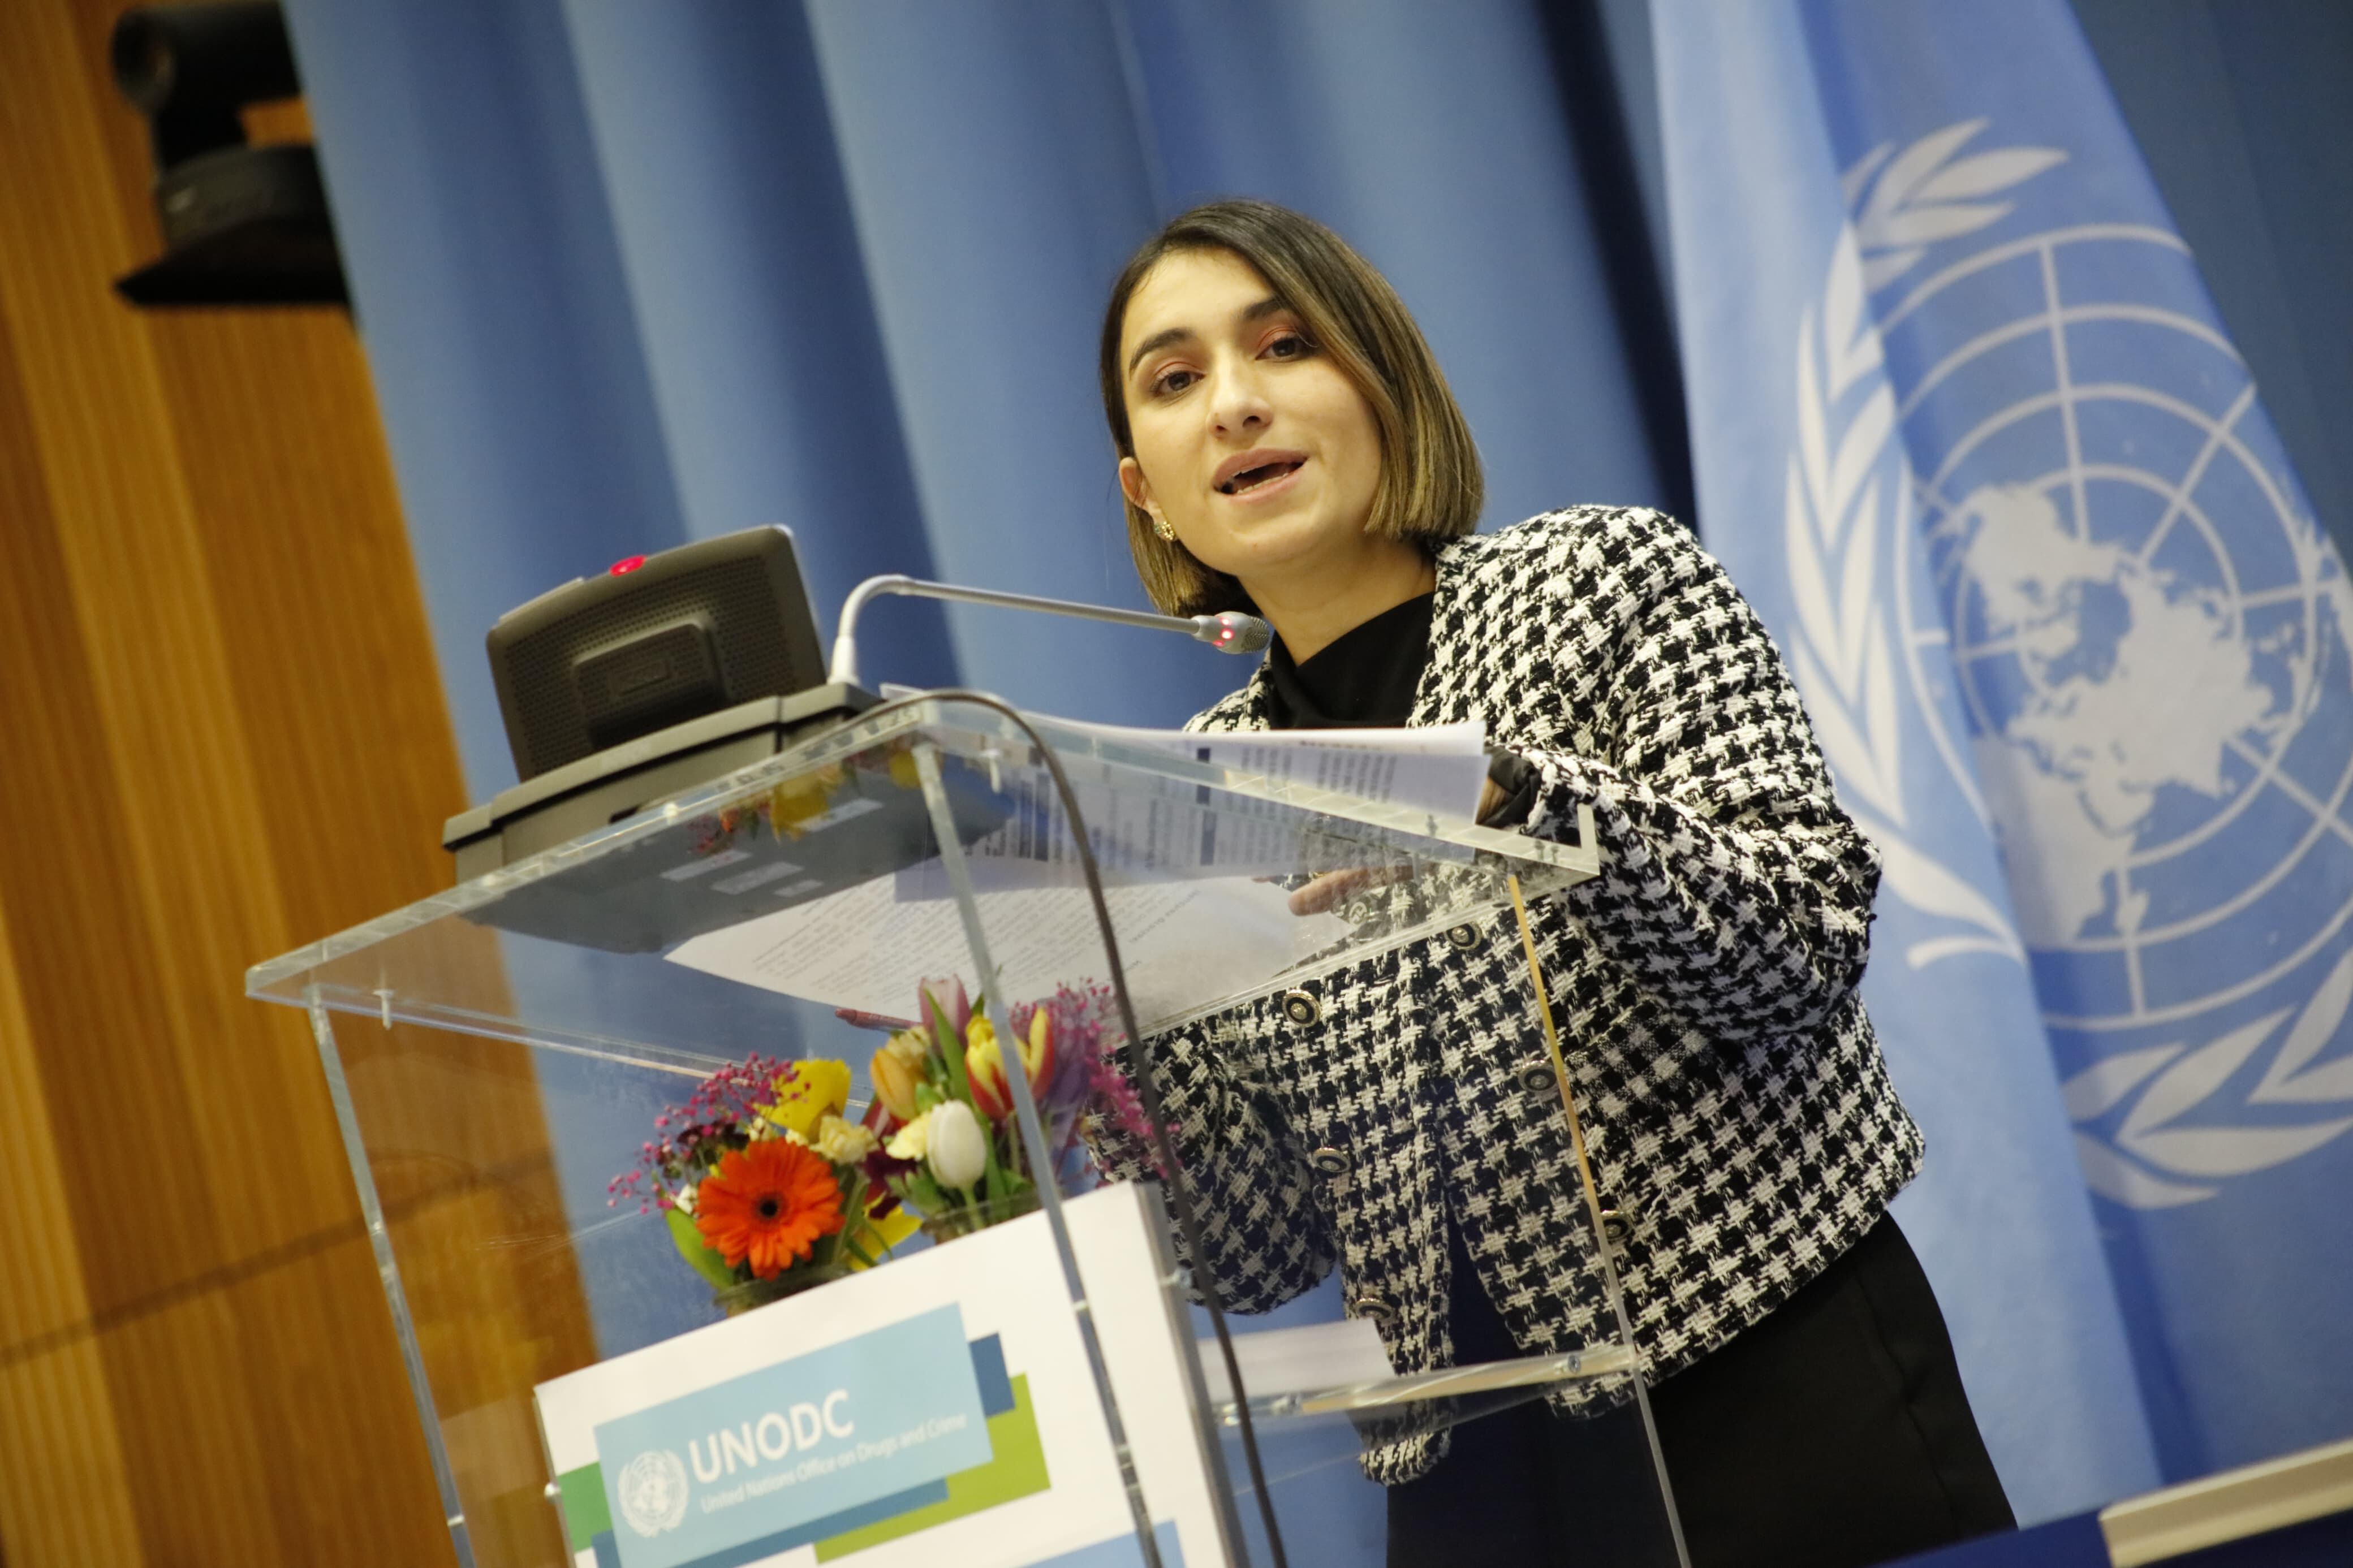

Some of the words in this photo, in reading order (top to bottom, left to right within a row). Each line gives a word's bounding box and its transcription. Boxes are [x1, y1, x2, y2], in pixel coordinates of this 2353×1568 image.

[688, 1389, 855, 1484] UNODC
[701, 1484, 745, 1513] United
[744, 1471, 797, 1500] Nations
[796, 1455, 837, 1482] Office
[837, 1449, 856, 1468] on
[856, 1436, 898, 1462] Drugs
[899, 1419, 926, 1448] and
[926, 1413, 968, 1438] Crime
